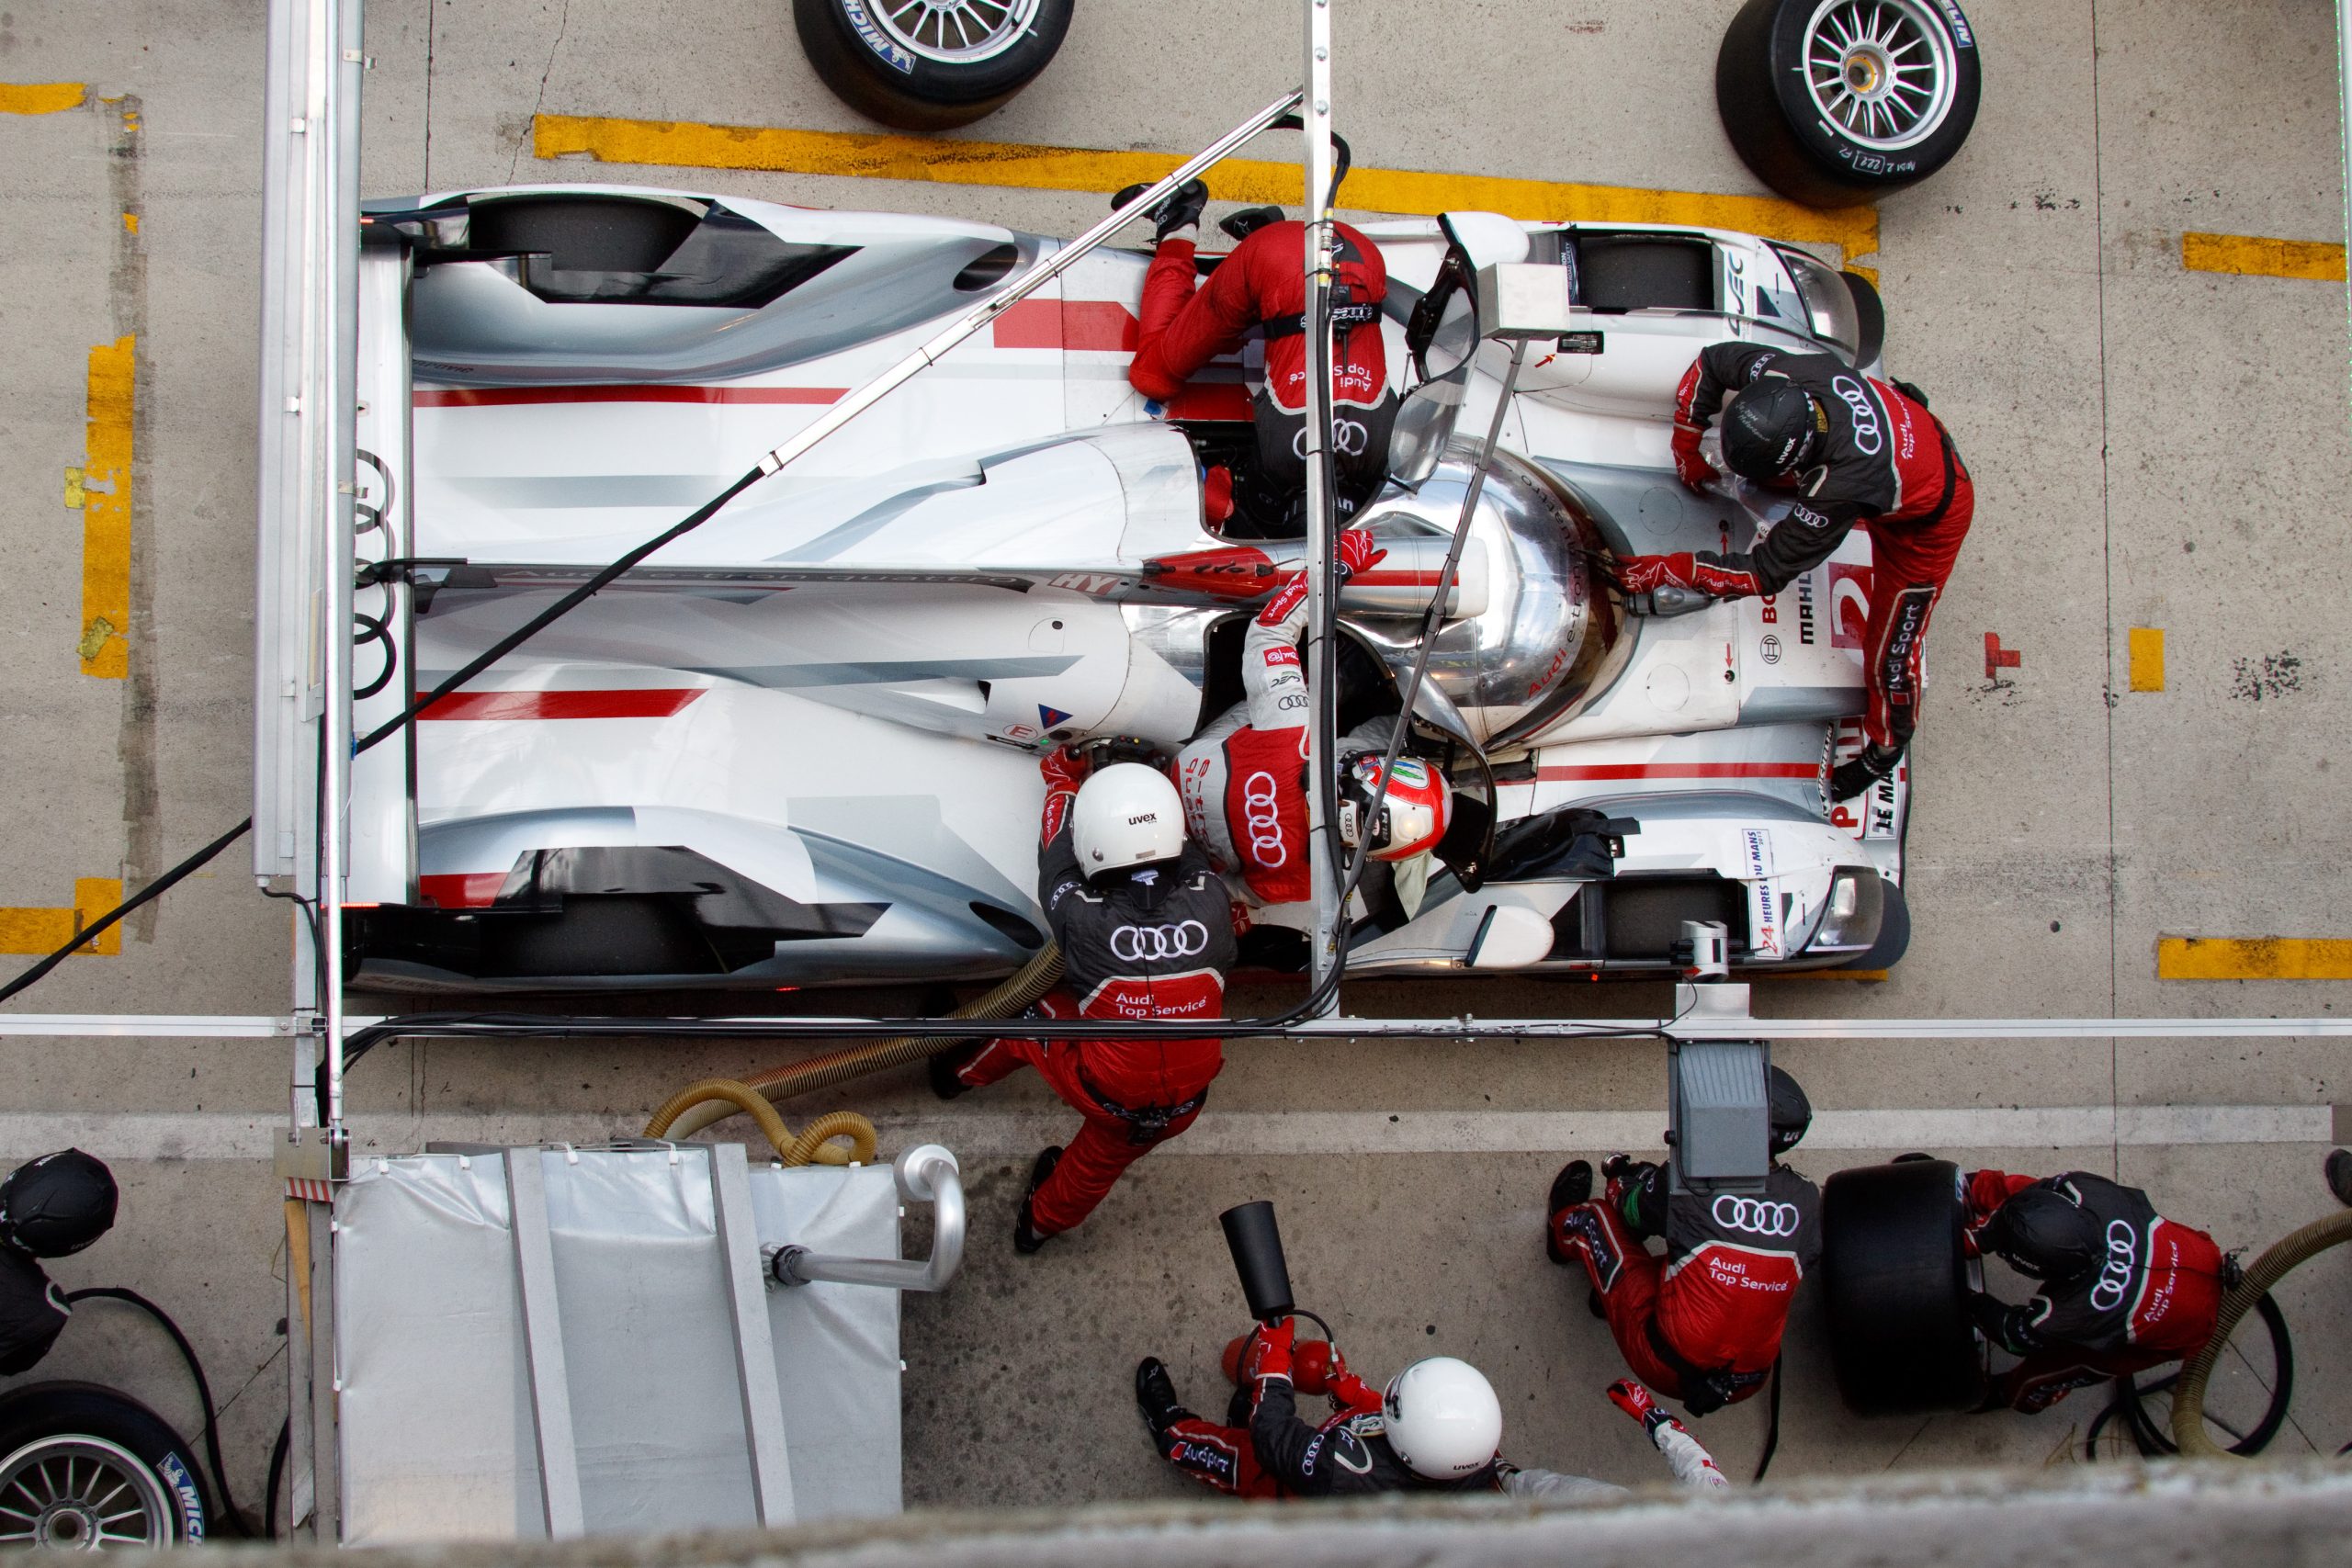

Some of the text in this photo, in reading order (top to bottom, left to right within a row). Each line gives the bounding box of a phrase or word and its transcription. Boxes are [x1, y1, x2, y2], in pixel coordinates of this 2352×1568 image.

[843, 0, 888, 51] MICH
[1940, 0, 1973, 45] ELIN
[1860, 156, 1882, 171] 222
[1339, 377, 1372, 391] Audi
[1347, 363, 1373, 382] Top
[1775, 437, 1796, 465] uvex
[1899, 423, 1909, 460] Audi
[1906, 434, 1915, 459] Top
[826, 574, 1018, 585] quattro
[1055, 572, 1118, 596] HY
[1707, 578, 1724, 588] Audi
[1267, 582, 1304, 619] Audi Sport
[1761, 592, 1778, 624] BO
[1798, 573, 1815, 645] MAHL
[1527, 648, 1567, 699] Audi
[1566, 565, 1582, 643] e-tron
[1891, 604, 1921, 655] Sport
[1876, 772, 1894, 829] LE MA
[1127, 812, 1158, 826] uvex
[1747, 830, 1762, 862] MANS
[1759, 885, 1774, 923] HEURES
[1761, 925, 1779, 956] 24
[1115, 992, 1155, 1006] Audi
[1115, 998, 1206, 1020] Top Service
[1710, 1257, 1747, 1275] Audi
[2012, 1253, 2041, 1272] uvex
[1710, 1268, 1787, 1292] Top Service
[2153, 1242, 2179, 1322] Top Service
[2144, 1288, 2165, 1323] Audi
[179, 1485, 204, 1549] MICH
